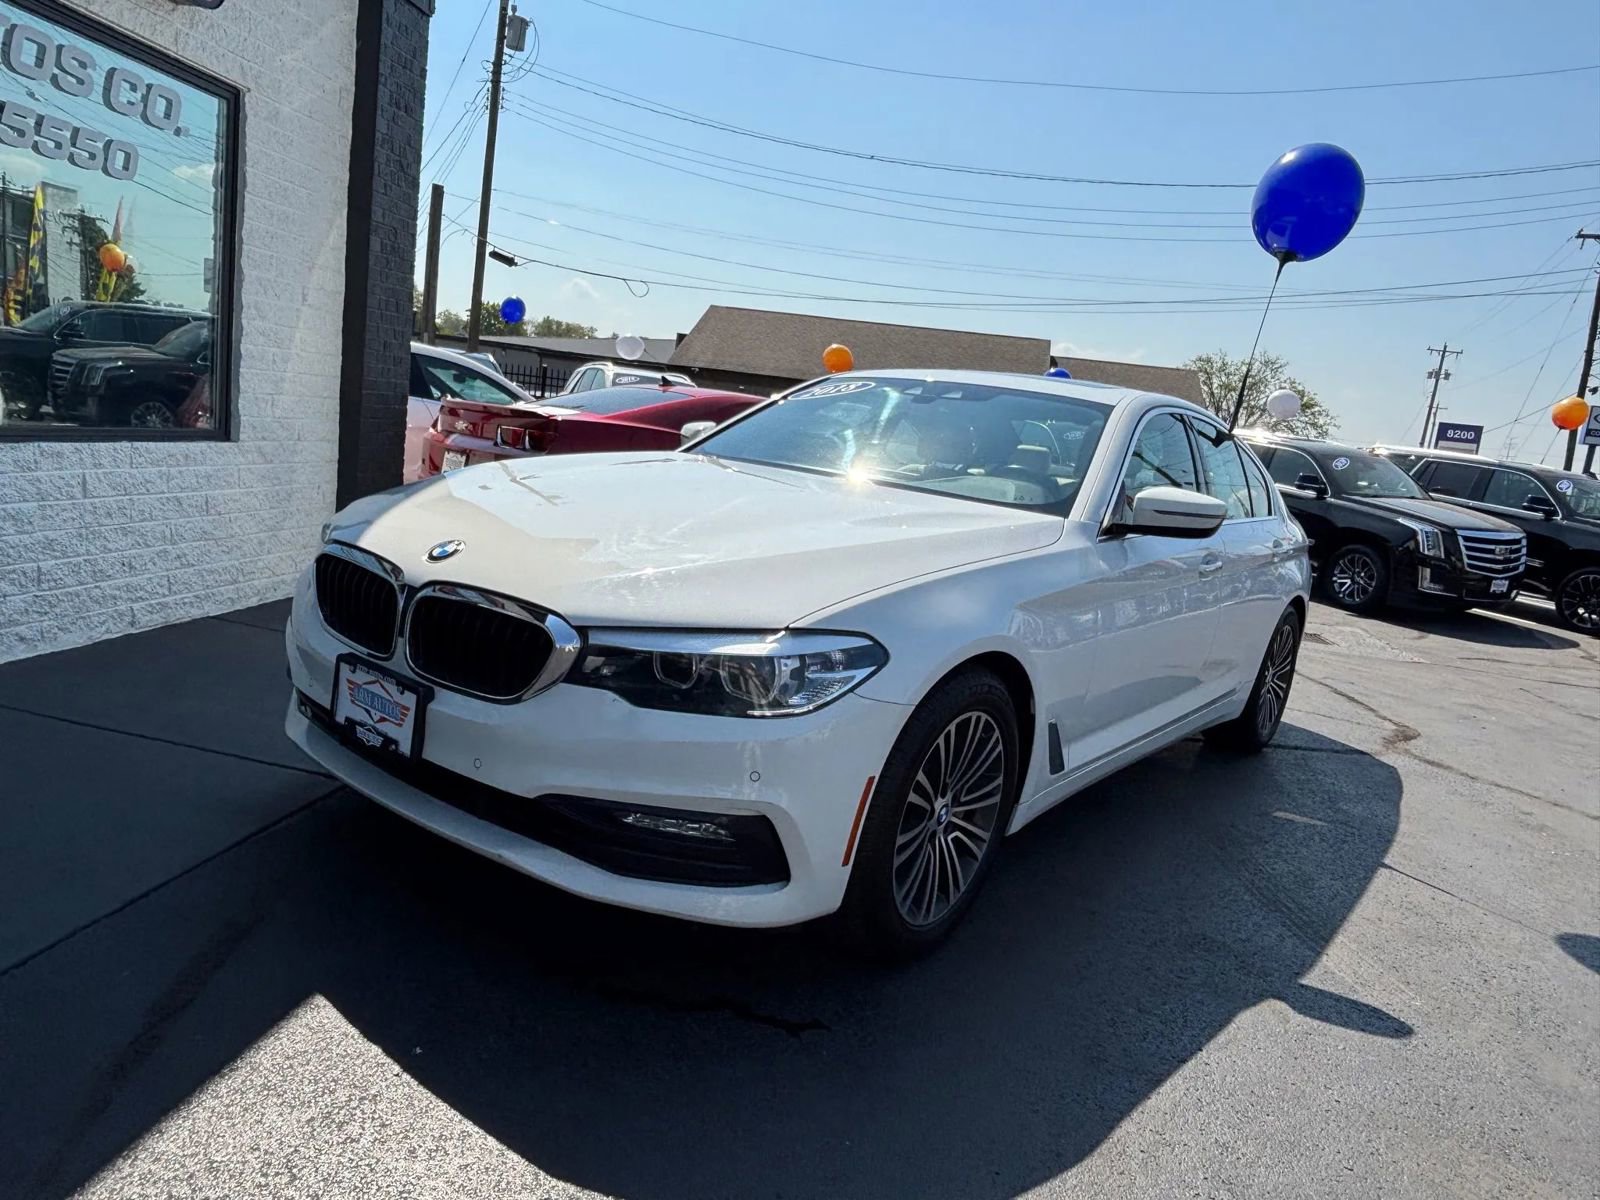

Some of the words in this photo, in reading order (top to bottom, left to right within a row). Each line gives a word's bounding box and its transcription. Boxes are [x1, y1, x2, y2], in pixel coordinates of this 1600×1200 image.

[0, 13, 97, 98] OS
[102, 66, 191, 137] CO.
[1446, 429, 1475, 440] 8200
